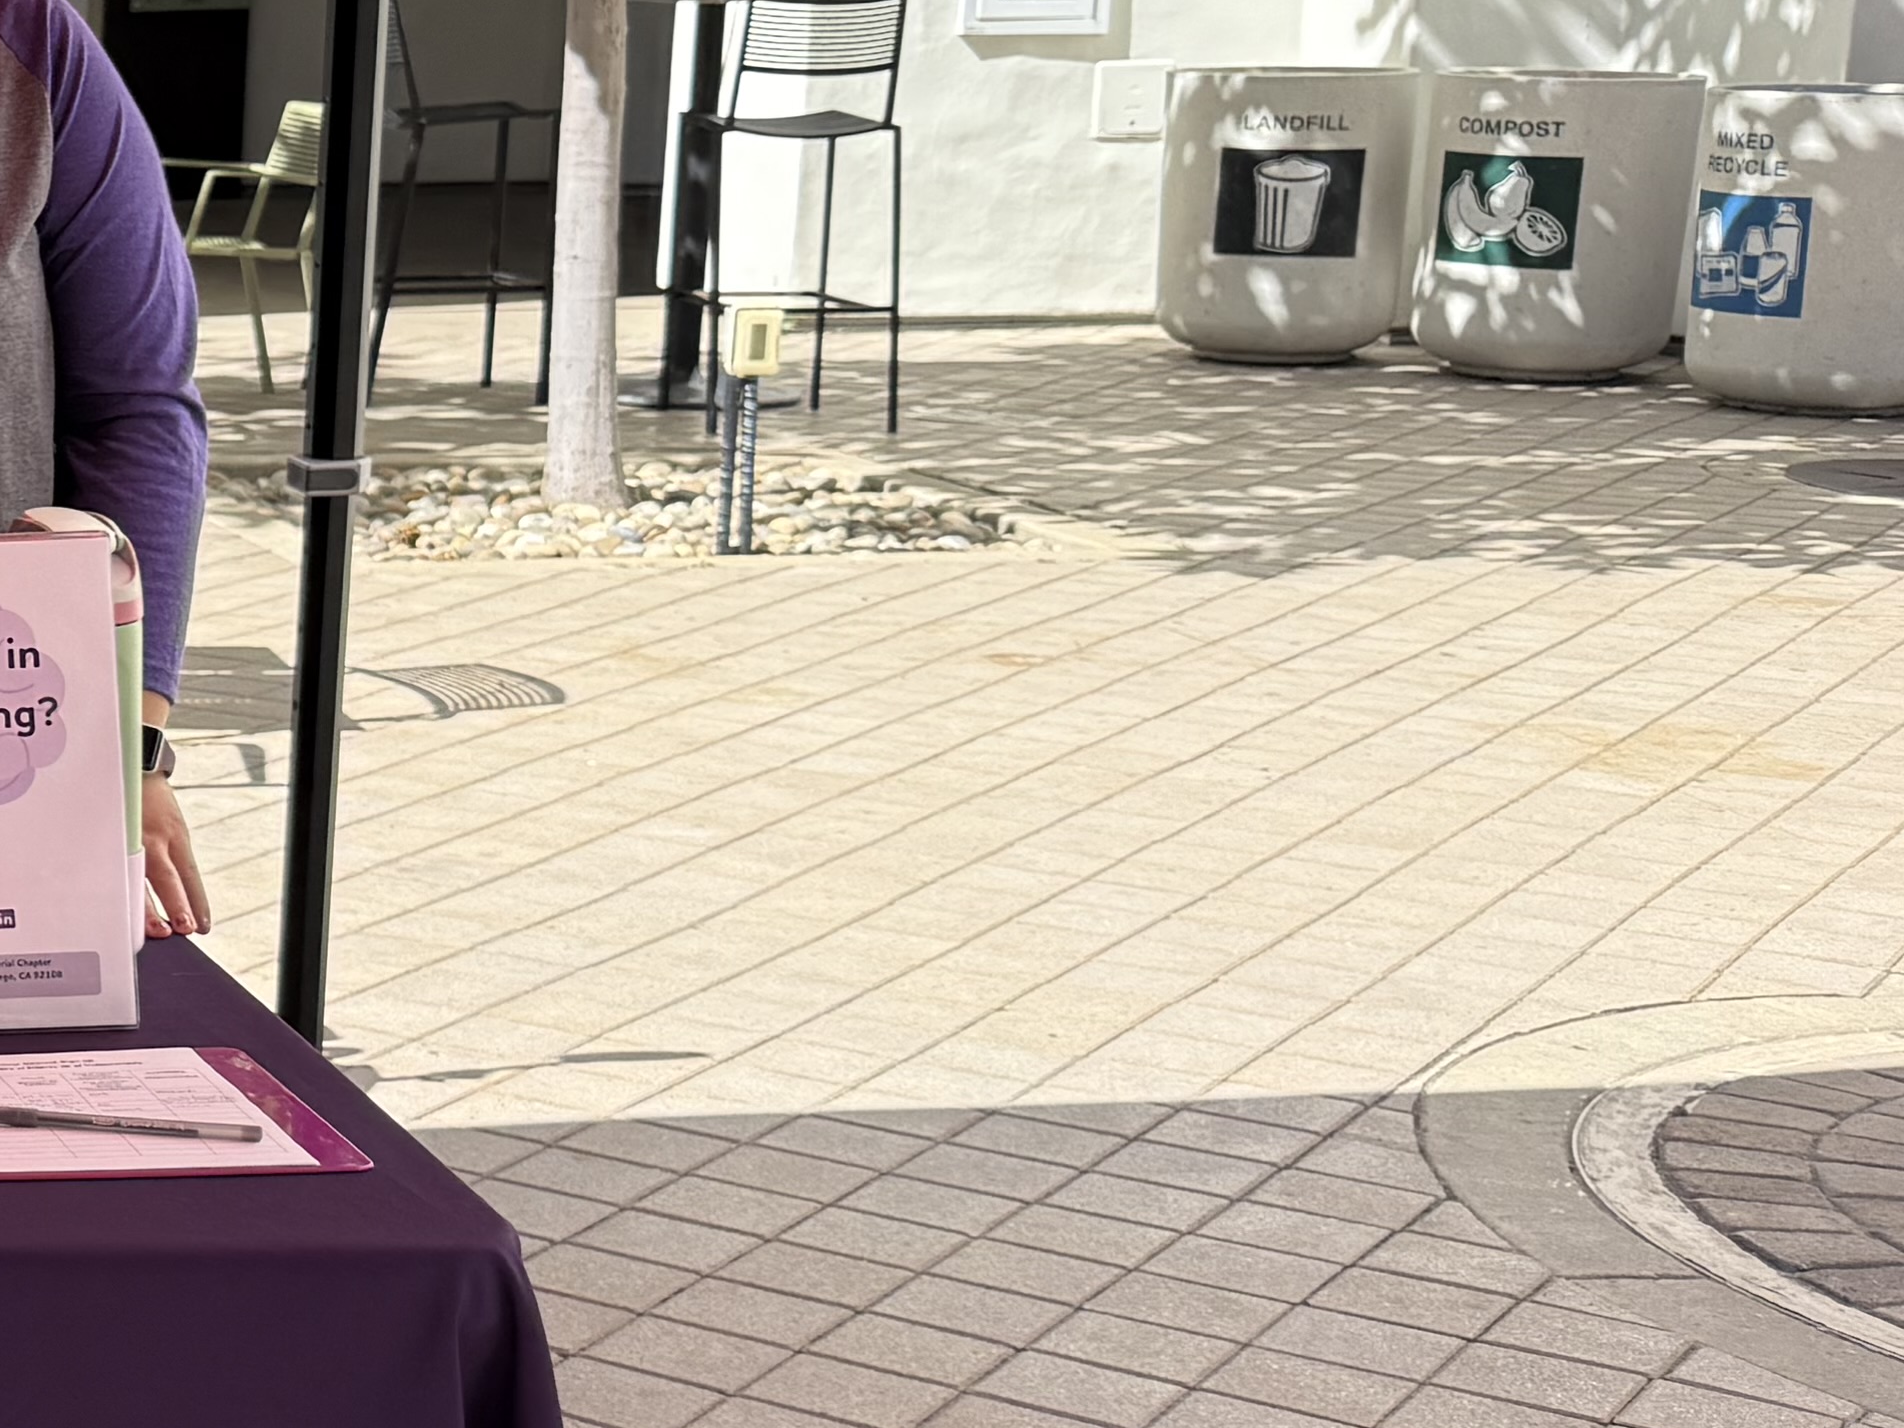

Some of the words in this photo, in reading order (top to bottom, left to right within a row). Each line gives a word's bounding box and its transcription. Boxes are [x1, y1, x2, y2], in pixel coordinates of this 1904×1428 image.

[1242, 114, 1349, 134] LANDFILL
[1460, 118, 1564, 140] COMPOST
[1717, 130, 1774, 150] MIXED
[1709, 154, 1789, 178] RECYCLE
[7, 638, 39, 668] in
[17, 958, 51, 967] Chapter
